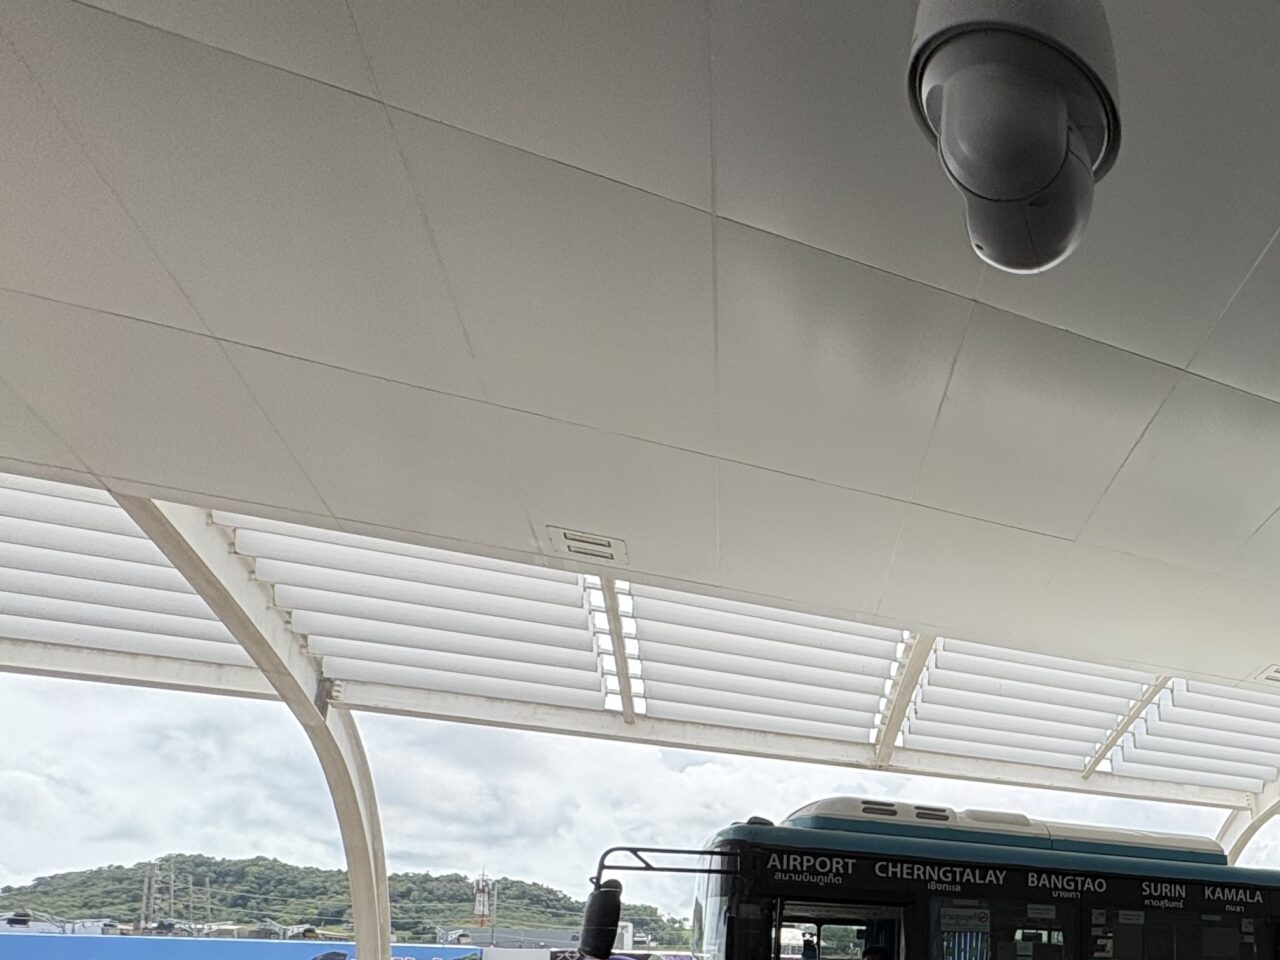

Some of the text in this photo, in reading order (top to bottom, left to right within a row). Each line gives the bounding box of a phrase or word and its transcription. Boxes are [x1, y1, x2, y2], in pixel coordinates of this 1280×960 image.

[766, 853, 856, 875] AIRPORT
[874, 861, 1007, 885] CHERNGTALAY
[1027, 872, 1107, 893] BANGTAO
[1141, 881, 1186, 898] SURIN
[1204, 885, 1264, 903] KAMALA
